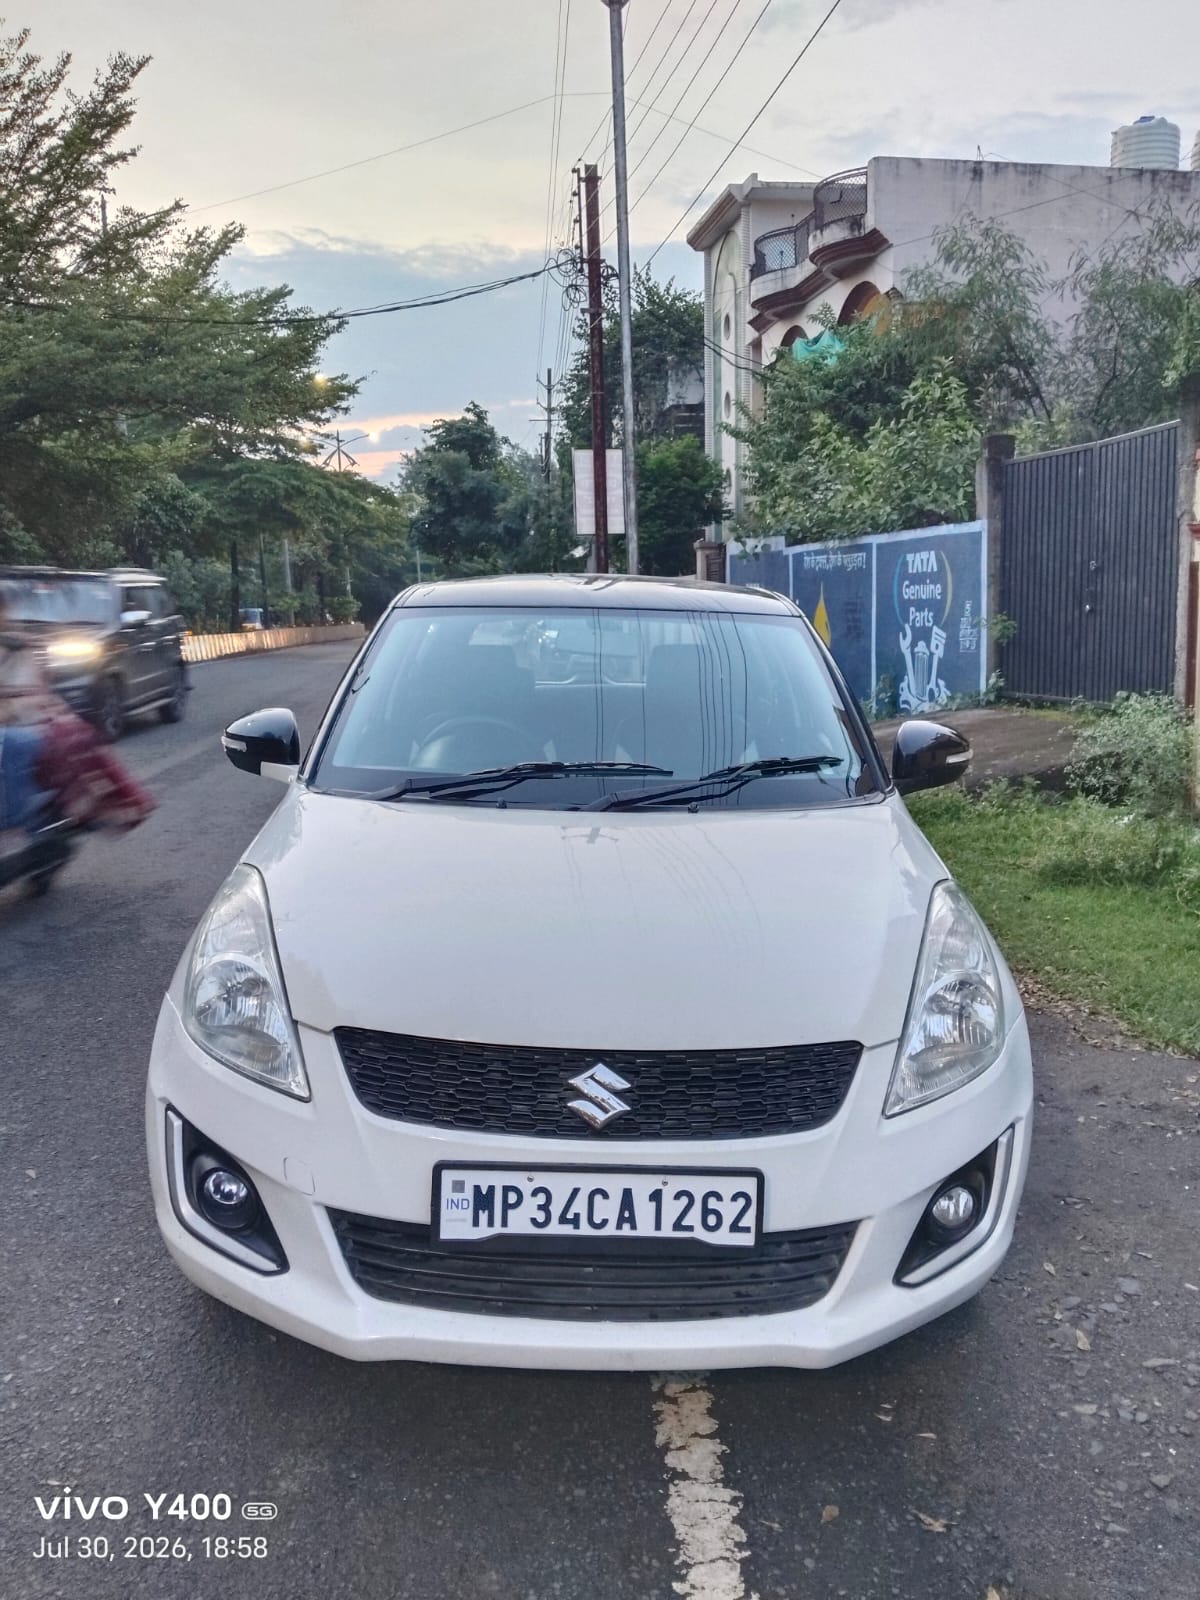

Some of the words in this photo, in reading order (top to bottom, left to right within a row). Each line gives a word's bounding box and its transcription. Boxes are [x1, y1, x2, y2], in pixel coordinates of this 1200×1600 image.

[906, 550, 938, 573] TATA
[902, 579, 942, 600] Genuine
[909, 606, 934, 627] Parts
[446, 1198, 470, 1211] IND
[472, 1184, 753, 1234] MP34CA1262
